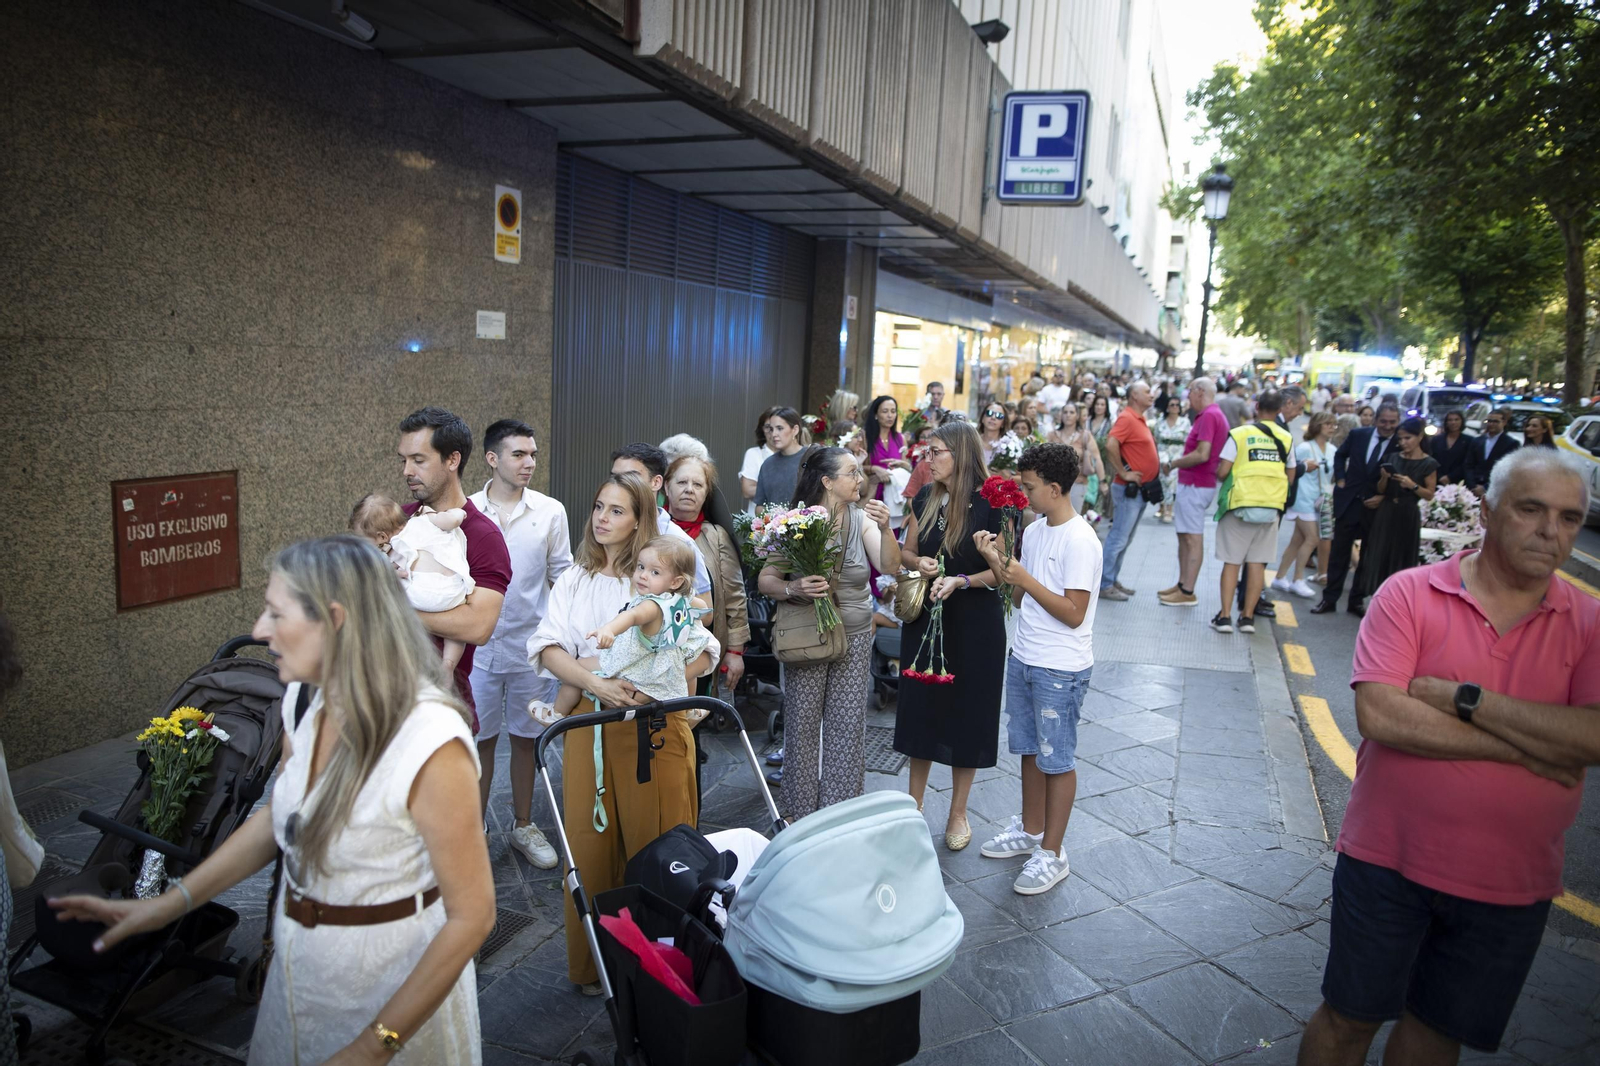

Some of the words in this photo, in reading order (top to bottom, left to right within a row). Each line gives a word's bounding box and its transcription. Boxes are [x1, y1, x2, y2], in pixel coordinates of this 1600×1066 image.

[1019, 104, 1070, 157] P
[1021, 183, 1058, 194] LIBRE
[127, 523, 155, 541] USO
[159, 513, 228, 537] EXCLUSIVO
[140, 539, 222, 567] BOMBEROS
